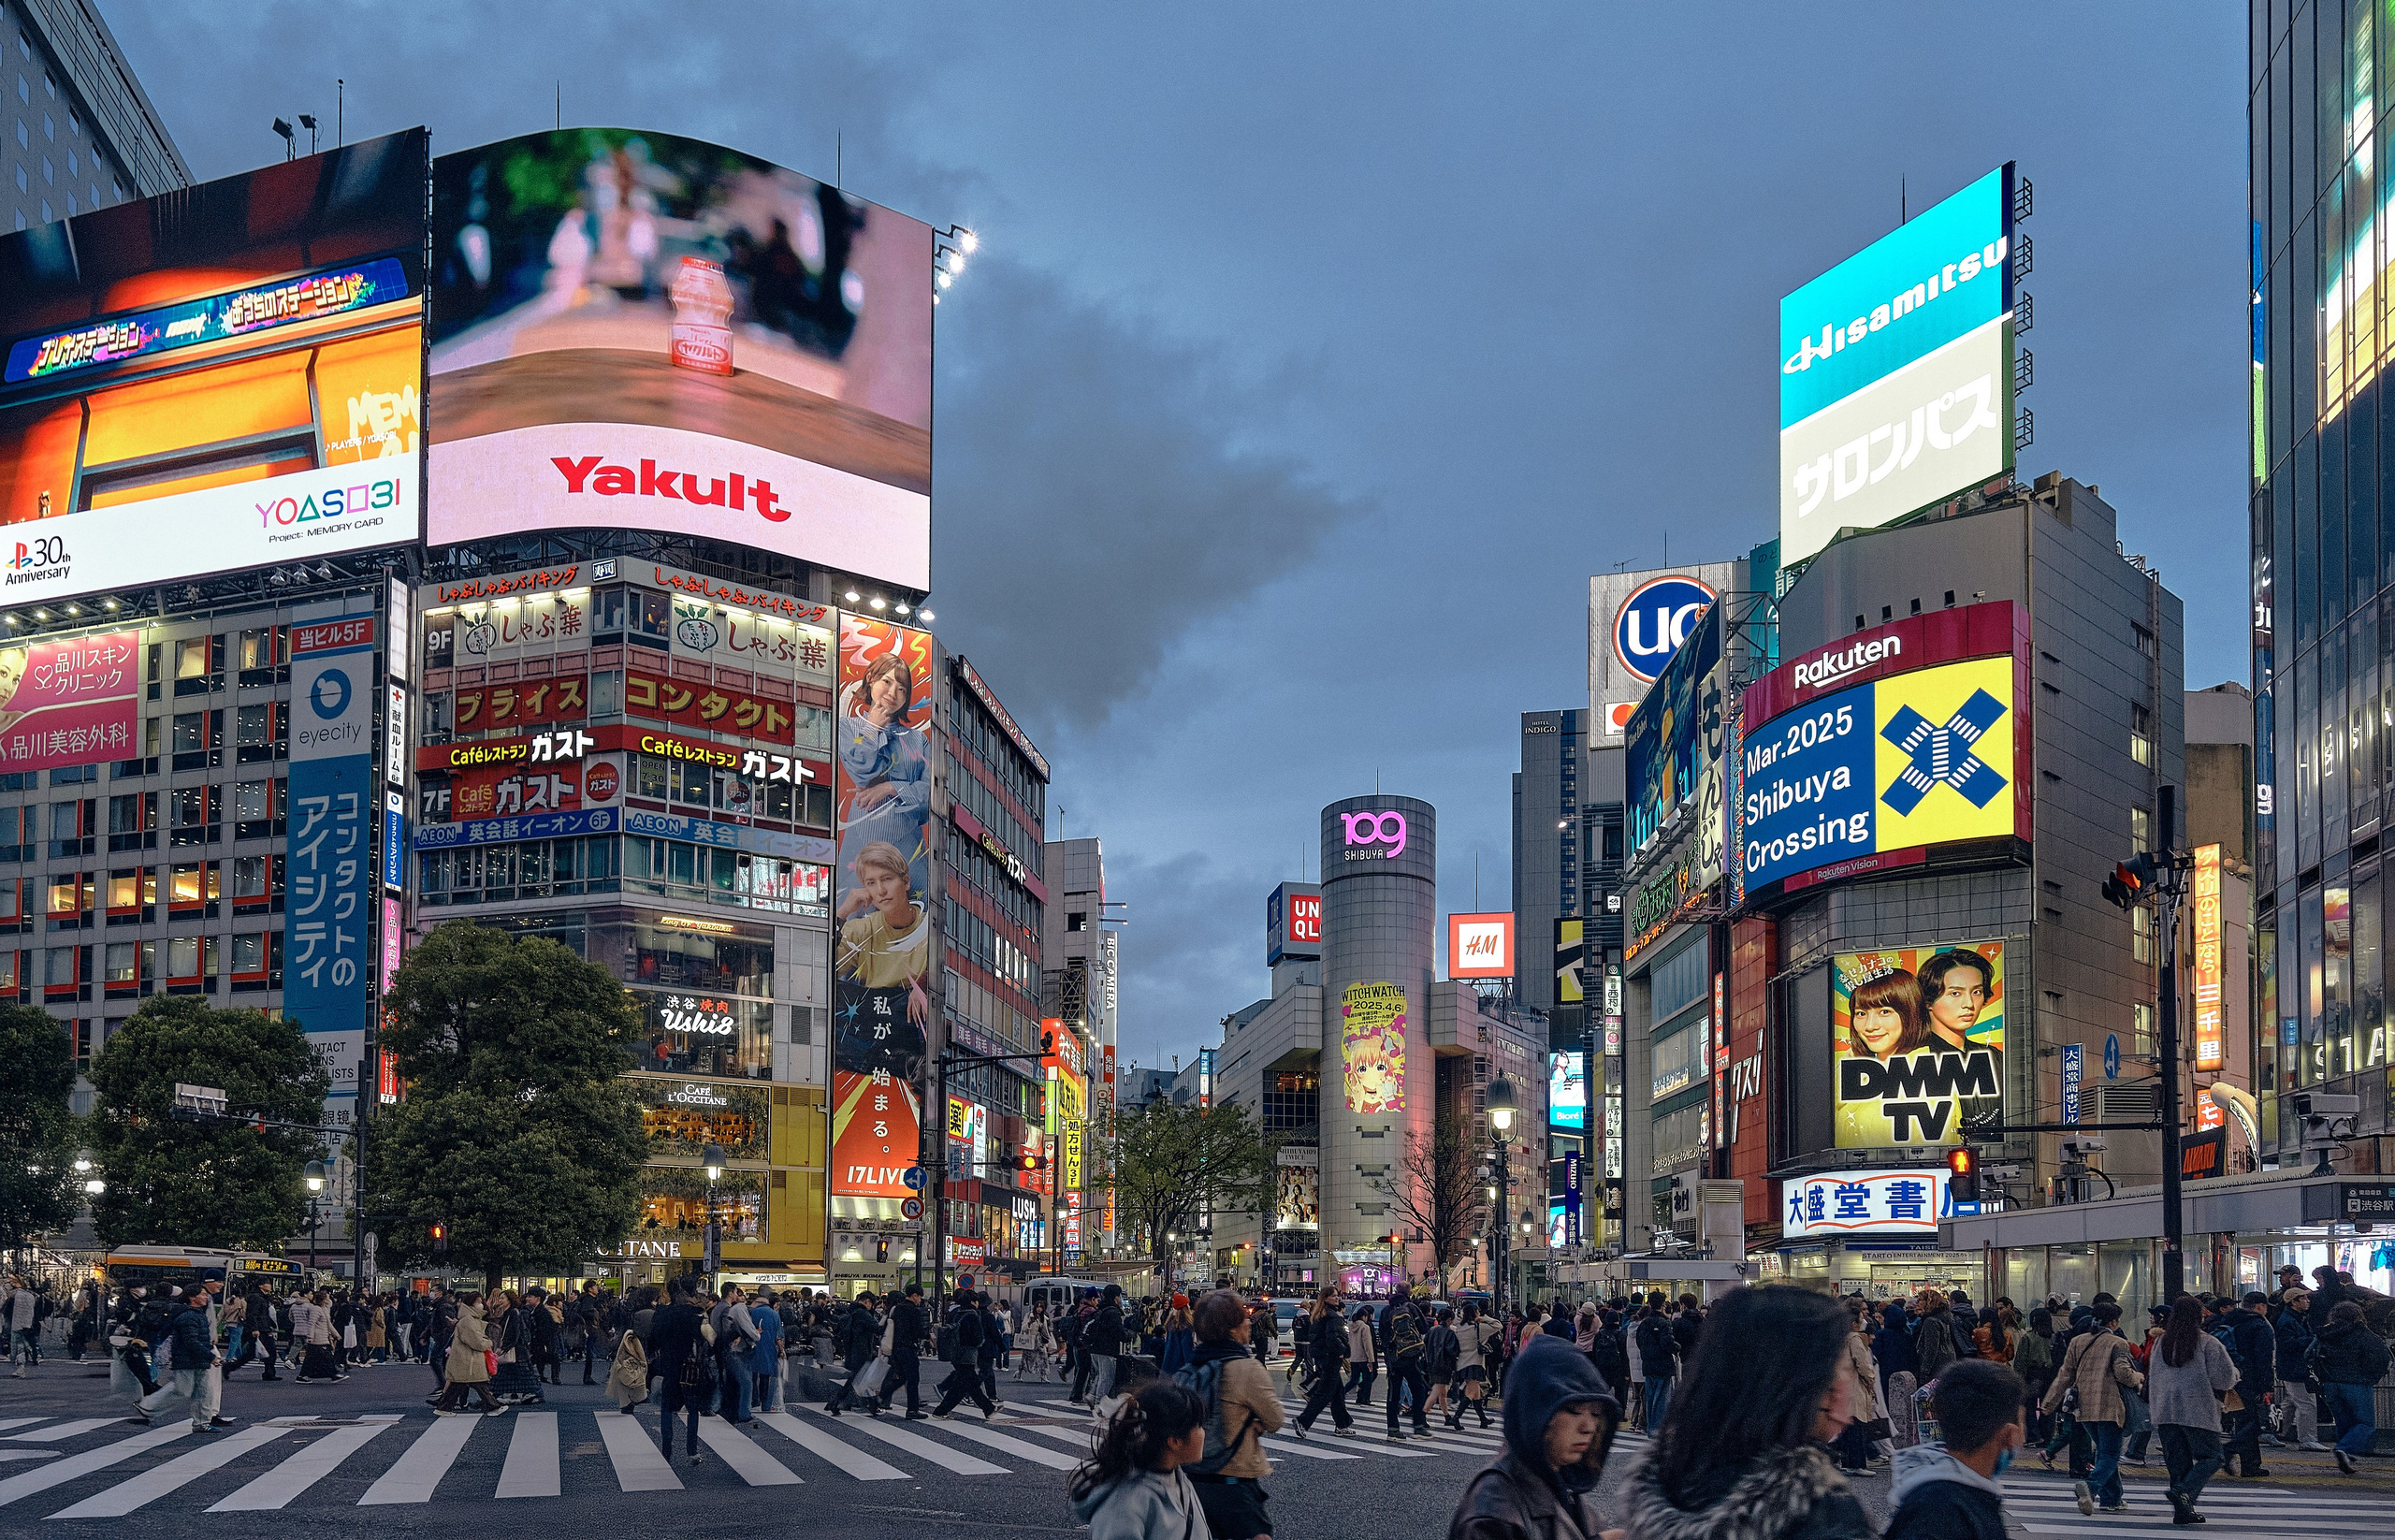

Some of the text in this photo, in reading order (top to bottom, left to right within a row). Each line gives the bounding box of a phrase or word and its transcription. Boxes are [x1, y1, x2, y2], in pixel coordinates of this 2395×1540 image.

[1783, 236, 2007, 374] Hisamitsu
[331, 436, 362, 451] PLAYERS
[1793, 372, 1997, 518] サロンパス
[551, 457, 791, 522] Yakult
[307, 522, 352, 538] MEMORY
[355, 516, 384, 531] CARD
[34, 535, 71, 568] 30th
[6, 565, 71, 587] Anniversary
[438, 565, 578, 603] しゃぶしゃぶバイキング
[594, 561, 615, 577] 寿司
[655, 566, 827, 621] しゃぶしゃぶバイキング
[299, 622, 365, 649] 当ビル5F
[502, 604, 582, 643] しゃぶ葉
[428, 630, 452, 650] 9F
[730, 621, 827, 669] しゃぶ葉
[55, 644, 132, 674] 品川スキン
[1794, 634, 1900, 689] Rakuten
[55, 668, 123, 696] クリニック
[457, 680, 583, 723] プライス
[628, 676, 790, 733] コンタクト
[10, 720, 129, 760] 品川美容外科
[299, 722, 361, 748] eyecity
[391, 709, 401, 773] 献血ルーム
[1525, 725, 1557, 734] INDIGO
[1747, 705, 1852, 777] Mar.2025
[531, 730, 594, 763] ガスト
[391, 774, 400, 783] 6F
[642, 760, 665, 770] OPEN
[743, 750, 815, 785] ガスト
[459, 784, 492, 802] Café
[496, 774, 573, 815] ガスト
[590, 778, 616, 792] ガスト
[1747, 764, 1851, 826] Shibuya
[424, 789, 451, 812] 7F
[459, 802, 491, 813] レストラン
[421, 814, 608, 842] AEON 英会話イーオン 6F
[632, 814, 681, 833] AEON
[1341, 811, 1406, 858] 109
[1344, 850, 1383, 861] SHIBUYA
[1747, 811, 1869, 872] Crossing
[1007, 852, 1026, 885] ガスト
[1817, 858, 1878, 879] Rakuten Vision
[295, 795, 329, 988] アイシティ
[331, 792, 358, 986] コンタクトの
[1295, 920, 1321, 939] QL
[1466, 935, 1498, 956] H&M
[2197, 849, 2220, 1063] クスリのことなら 三千里
[1106, 937, 1115, 1010] BIC CAMERA
[1838, 955, 1894, 982] 幸せカナコの
[1844, 965, 1894, 993] 殺し屋生活
[1354, 1001, 1401, 1012] 2025.4.6
[309, 1042, 346, 1053] ONTACT
[1105, 1054, 1113, 1073] 免税
[1841, 1053, 1997, 1100] DMM
[383, 1095, 394, 1104] 7F
[2065, 1047, 2080, 1124] 大盛堂商事ビル
[951, 1103, 961, 1133] 薬
[1884, 1101, 1952, 1141] TV
[1068, 1121, 1080, 1168] 処方せん
[1012, 1197, 1036, 1221] LUSH
[2361, 1200, 2394, 1211] 渋谷駅
